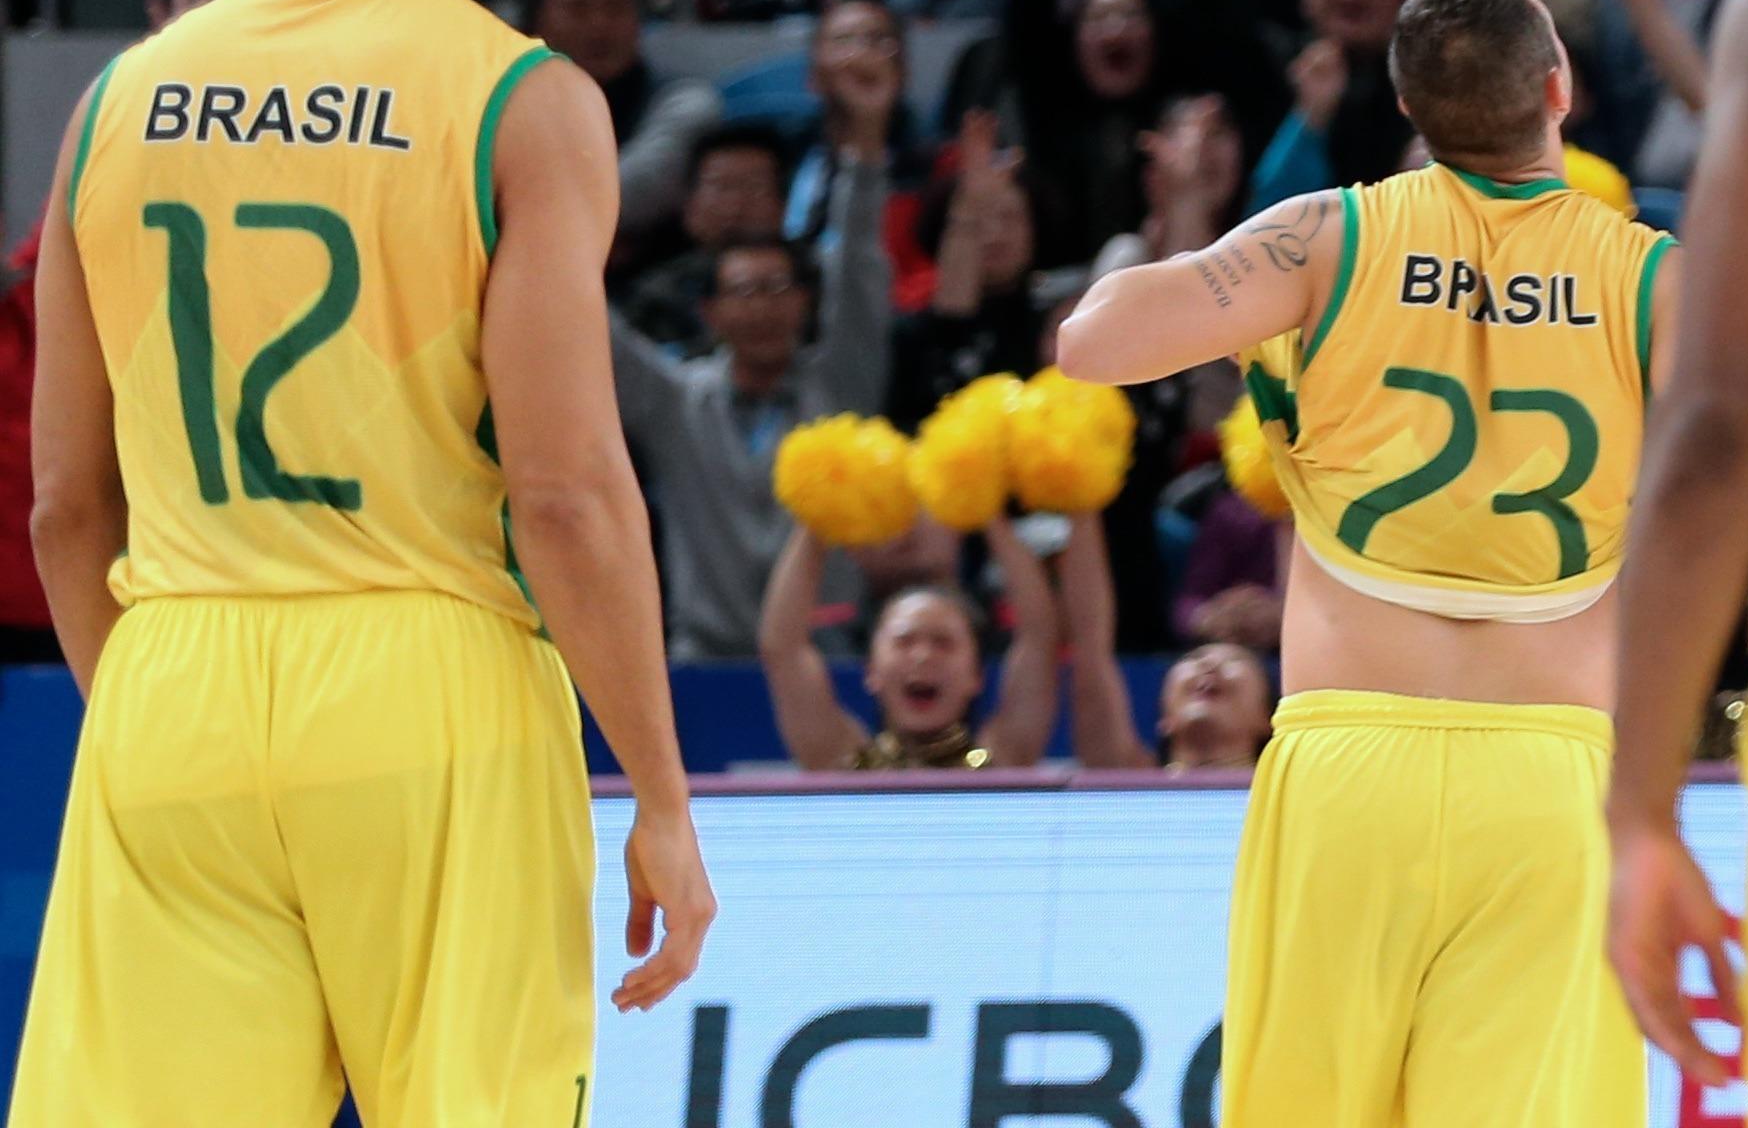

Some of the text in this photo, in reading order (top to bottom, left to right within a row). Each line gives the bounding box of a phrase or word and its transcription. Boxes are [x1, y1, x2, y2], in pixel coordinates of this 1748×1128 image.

[142, 82, 411, 151] BRASIL
[1401, 253, 1600, 327] BRASIL
[142, 202, 363, 512] 12
[1337, 366, 1600, 580] 23
[684, 1001, 1223, 1128] ICB
